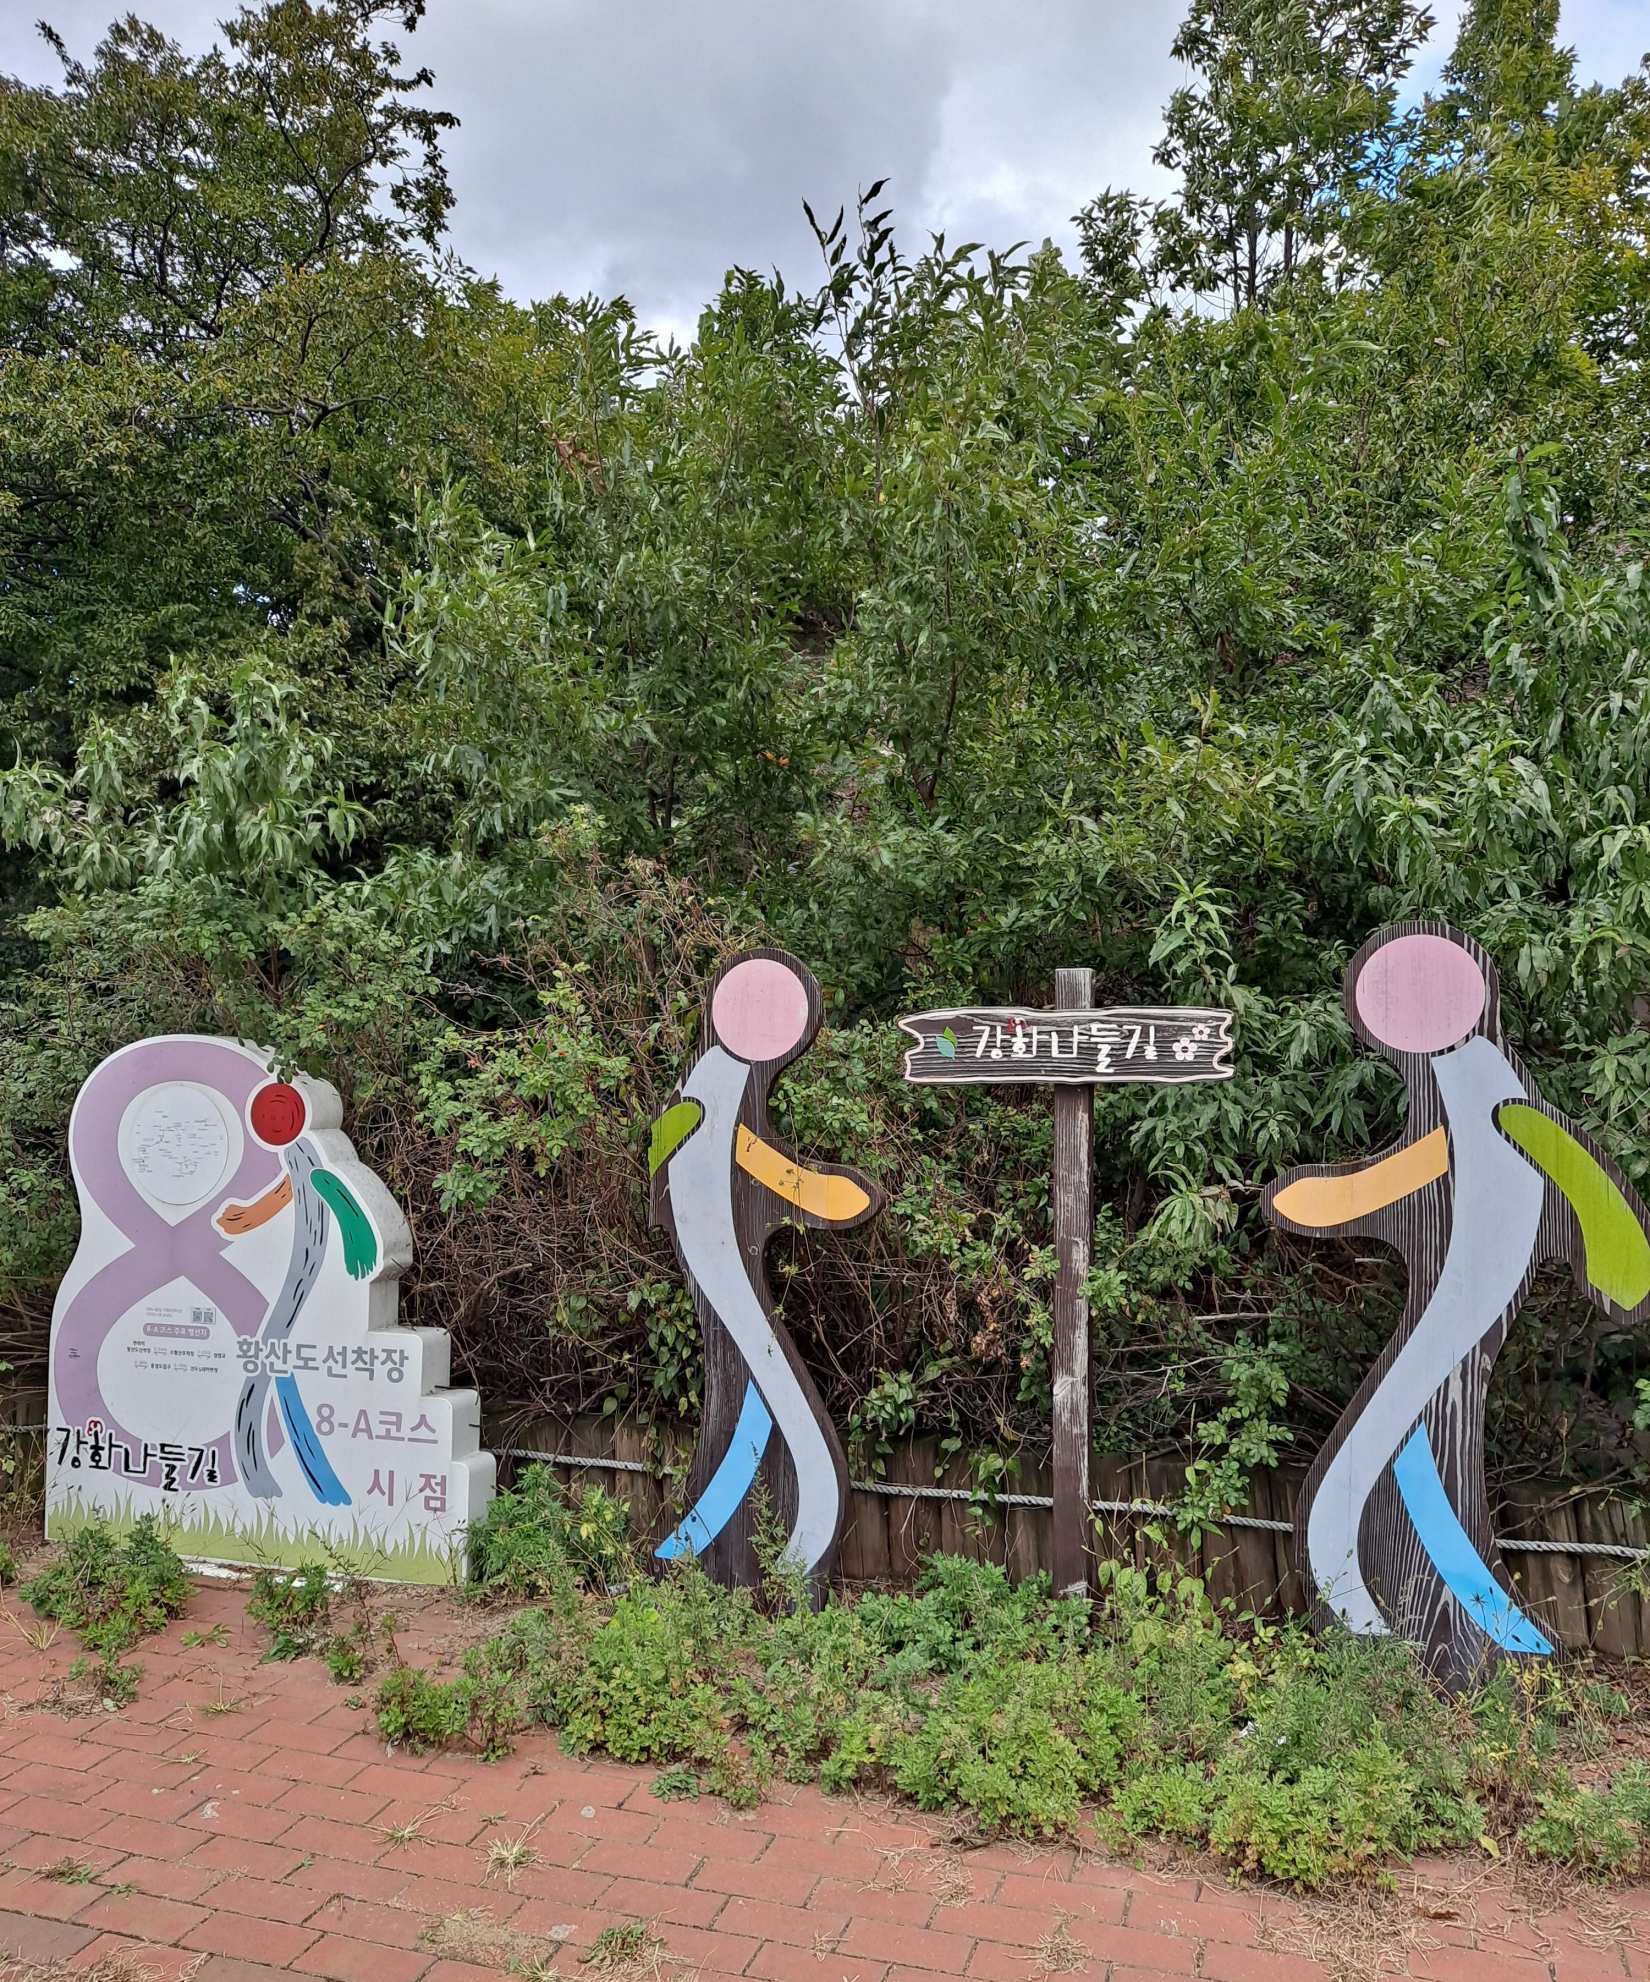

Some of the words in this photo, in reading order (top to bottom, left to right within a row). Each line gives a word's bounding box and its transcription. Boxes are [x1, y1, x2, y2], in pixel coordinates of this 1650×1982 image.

[972, 1020, 1158, 1073] 강화나들길
[236, 1338, 409, 1383] 황산도선착장
[316, 1403, 439, 1444] 8-A코스
[56, 1424, 218, 1492] 강화나들길
